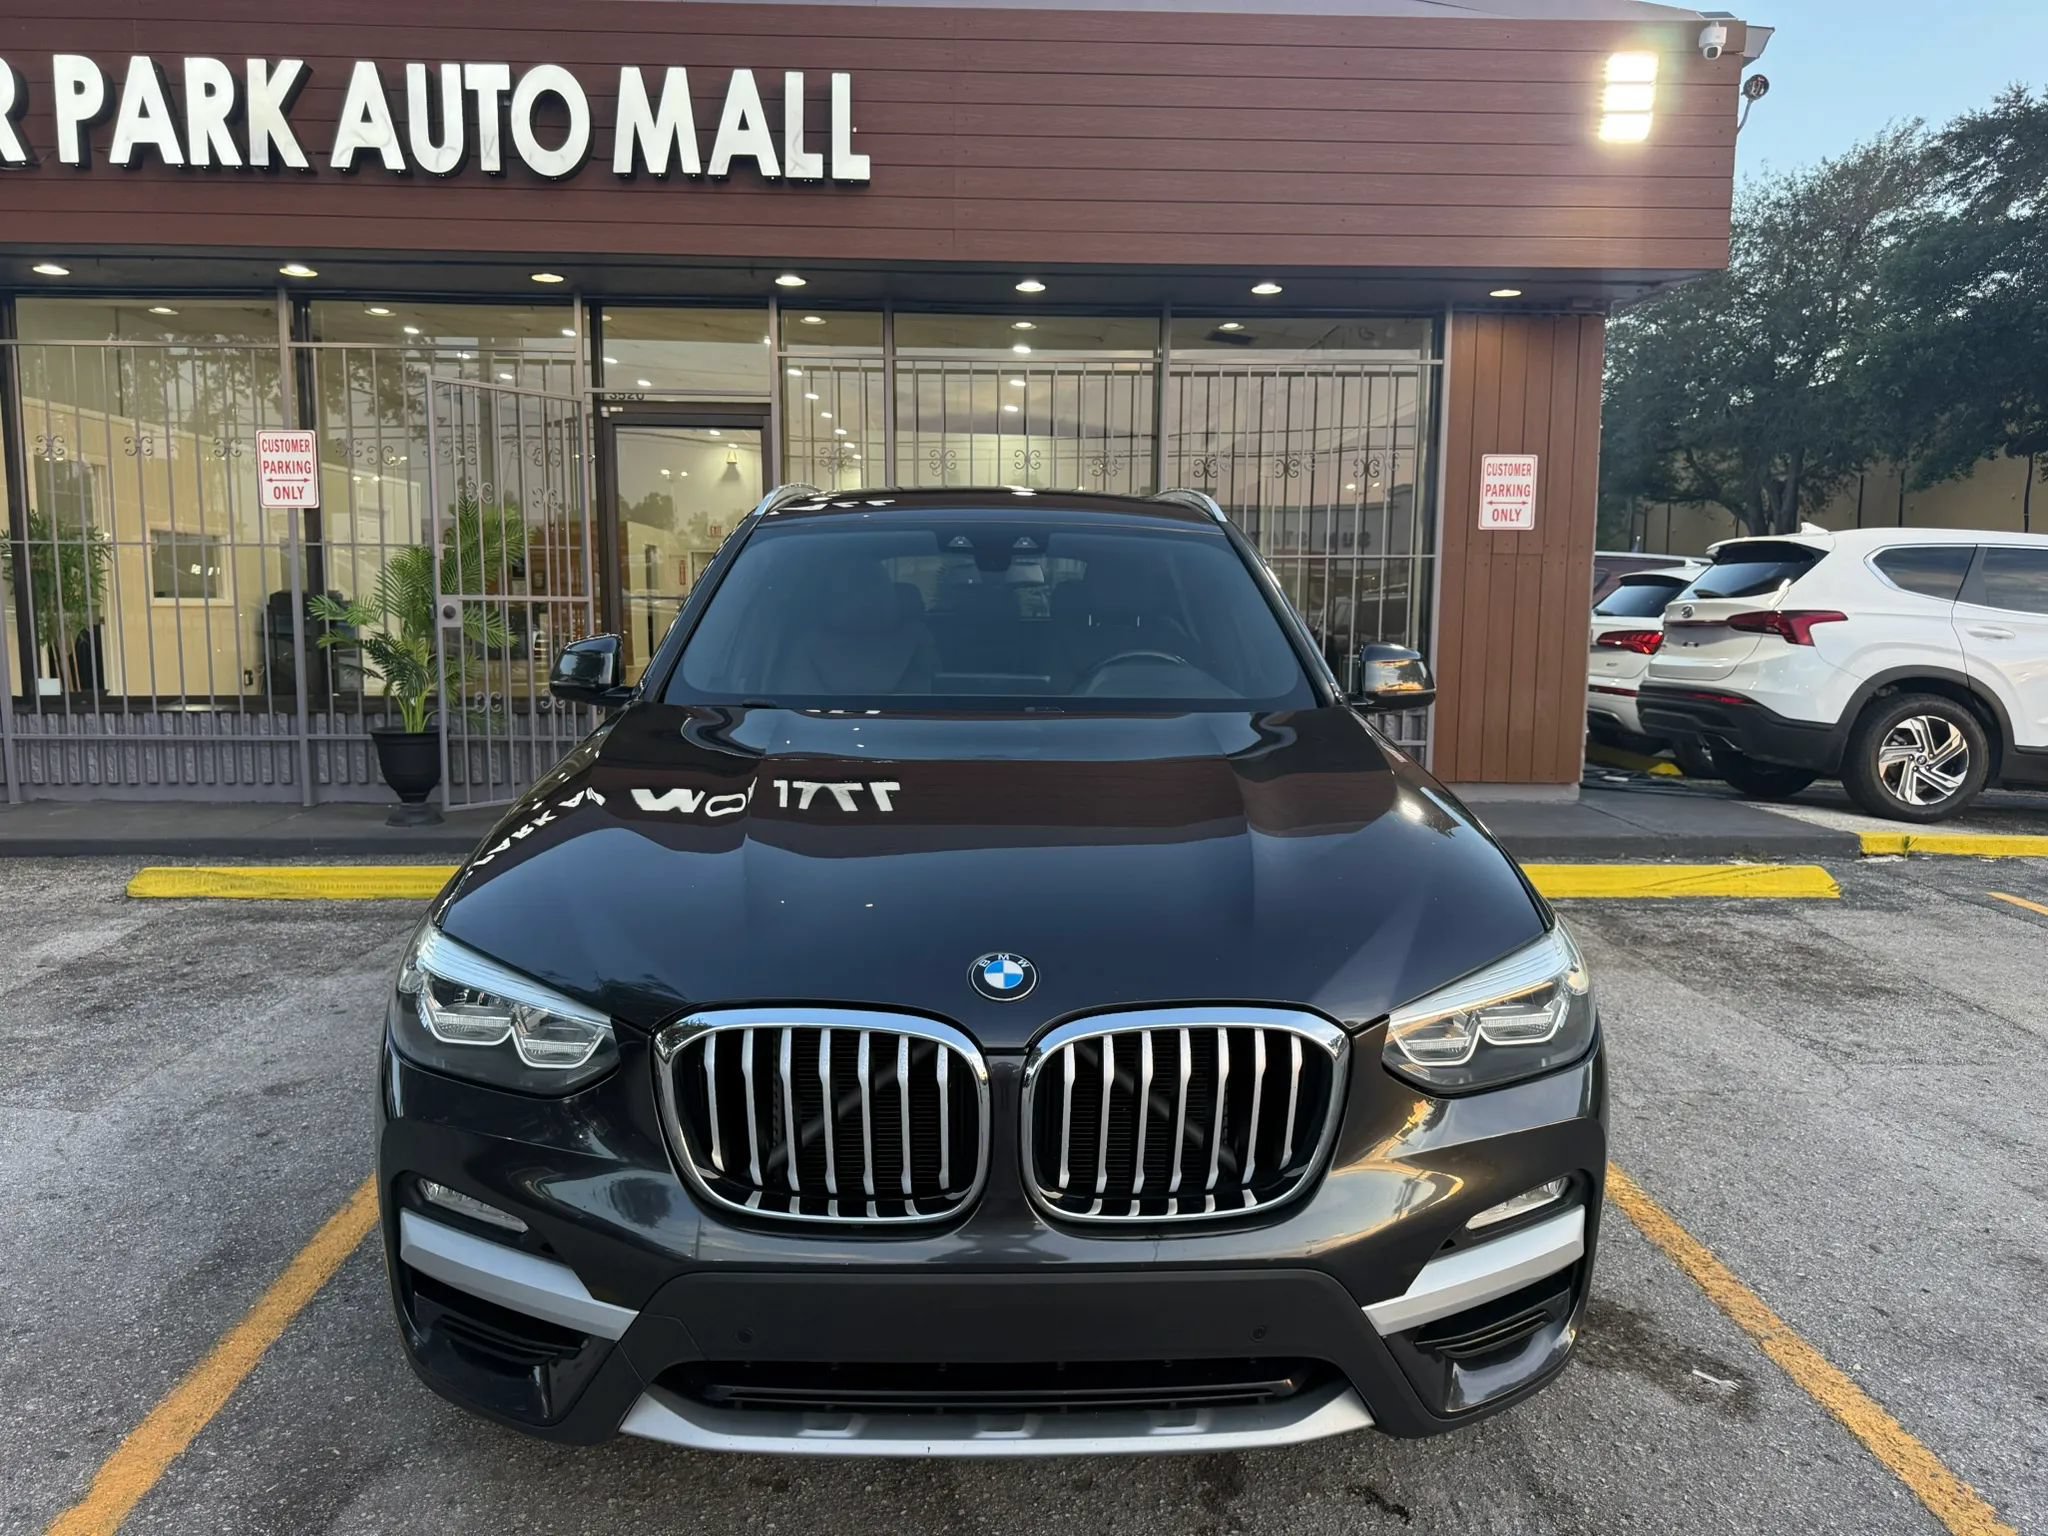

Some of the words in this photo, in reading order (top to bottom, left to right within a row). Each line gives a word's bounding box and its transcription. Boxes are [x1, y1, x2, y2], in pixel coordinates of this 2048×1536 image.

[53, 54, 311, 168] PARK
[329, 61, 592, 178] AUTO
[612, 66, 871, 182] MALL
[262, 439, 311, 452] CUSTOMER
[263, 461, 312, 474] PARKING
[1486, 463, 1532, 476] CUSTOMER
[273, 486, 305, 500] ONLY
[1485, 484, 1531, 497] PARKING
[1492, 508, 1522, 522] ONLY
[978, 953, 1030, 968] BMW
